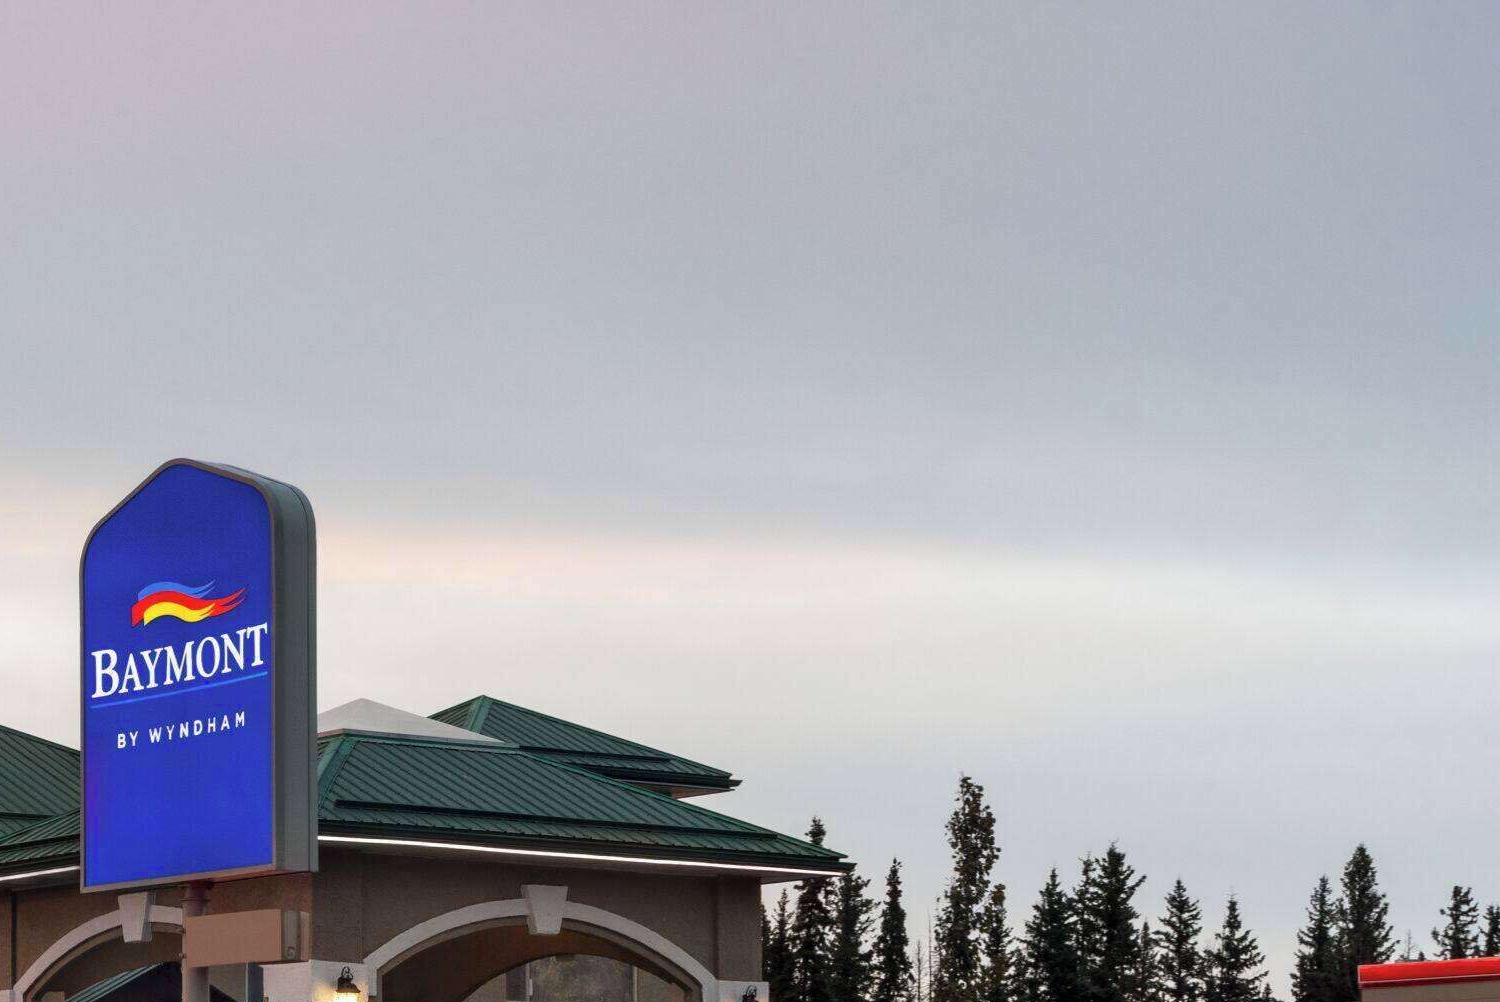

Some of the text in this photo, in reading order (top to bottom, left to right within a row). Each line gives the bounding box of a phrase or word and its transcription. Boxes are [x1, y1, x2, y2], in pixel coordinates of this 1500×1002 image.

[91, 622, 268, 699] BAYMONT
[117, 711, 246, 749] BY WYNDHAM
